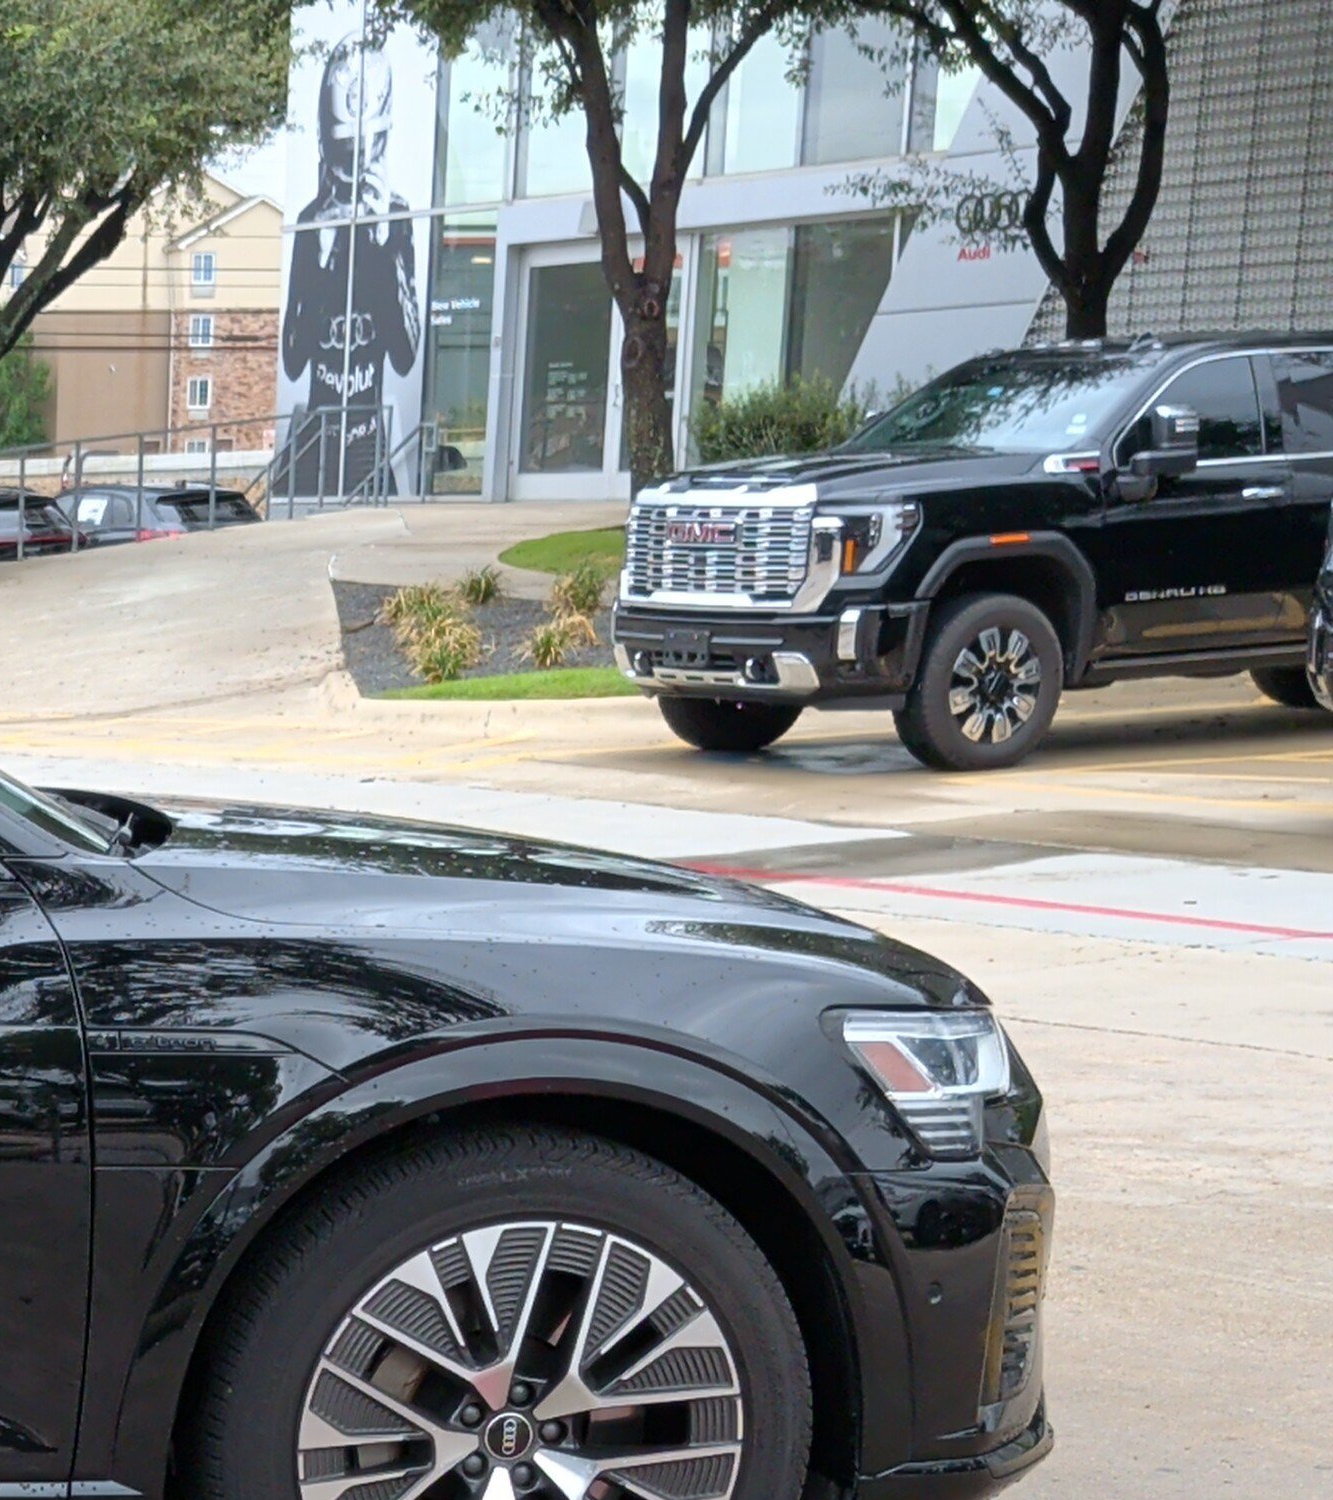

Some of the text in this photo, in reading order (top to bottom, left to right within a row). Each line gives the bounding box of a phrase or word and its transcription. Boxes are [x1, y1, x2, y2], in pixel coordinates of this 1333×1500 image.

[958, 244, 991, 261] Audi
[668, 522, 736, 543] GMC
[1125, 585, 1204, 602] DENALI
